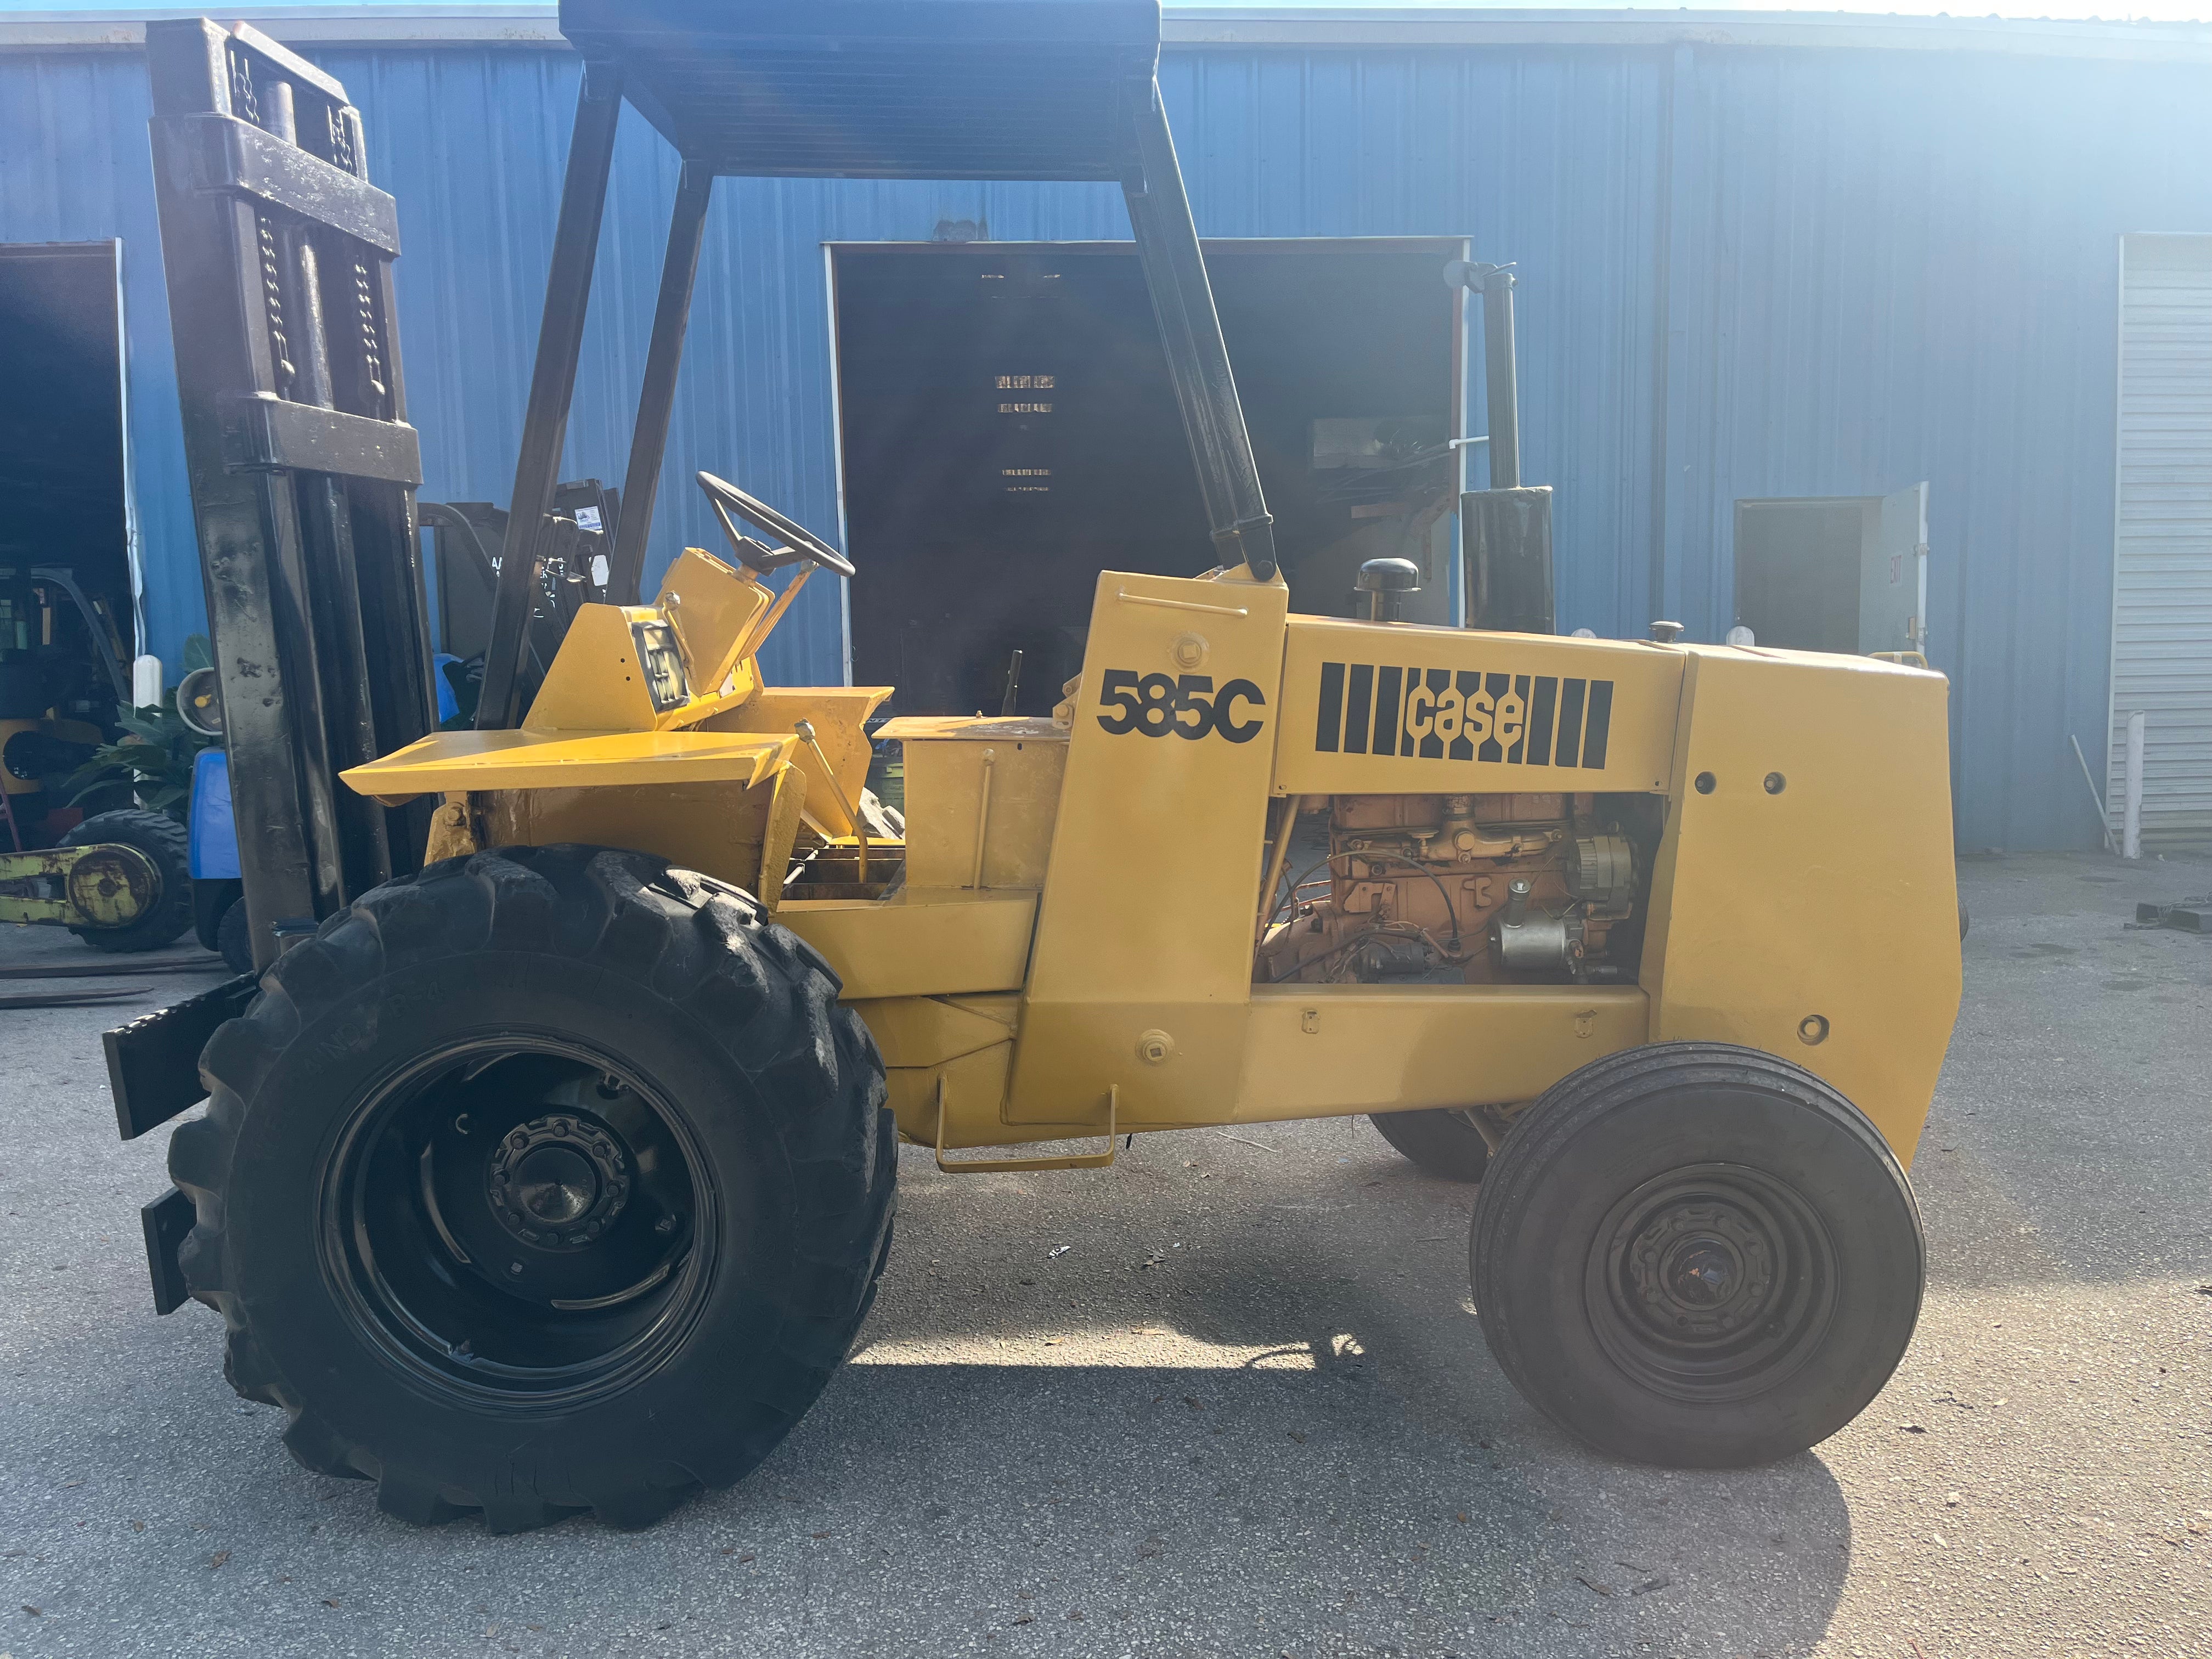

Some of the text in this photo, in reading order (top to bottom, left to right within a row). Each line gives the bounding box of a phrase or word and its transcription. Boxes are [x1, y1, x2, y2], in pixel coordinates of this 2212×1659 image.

[1891, 555, 1901, 584] EXIT
[1096, 668, 1266, 743] 585C
[1406, 685, 1525, 748] case
